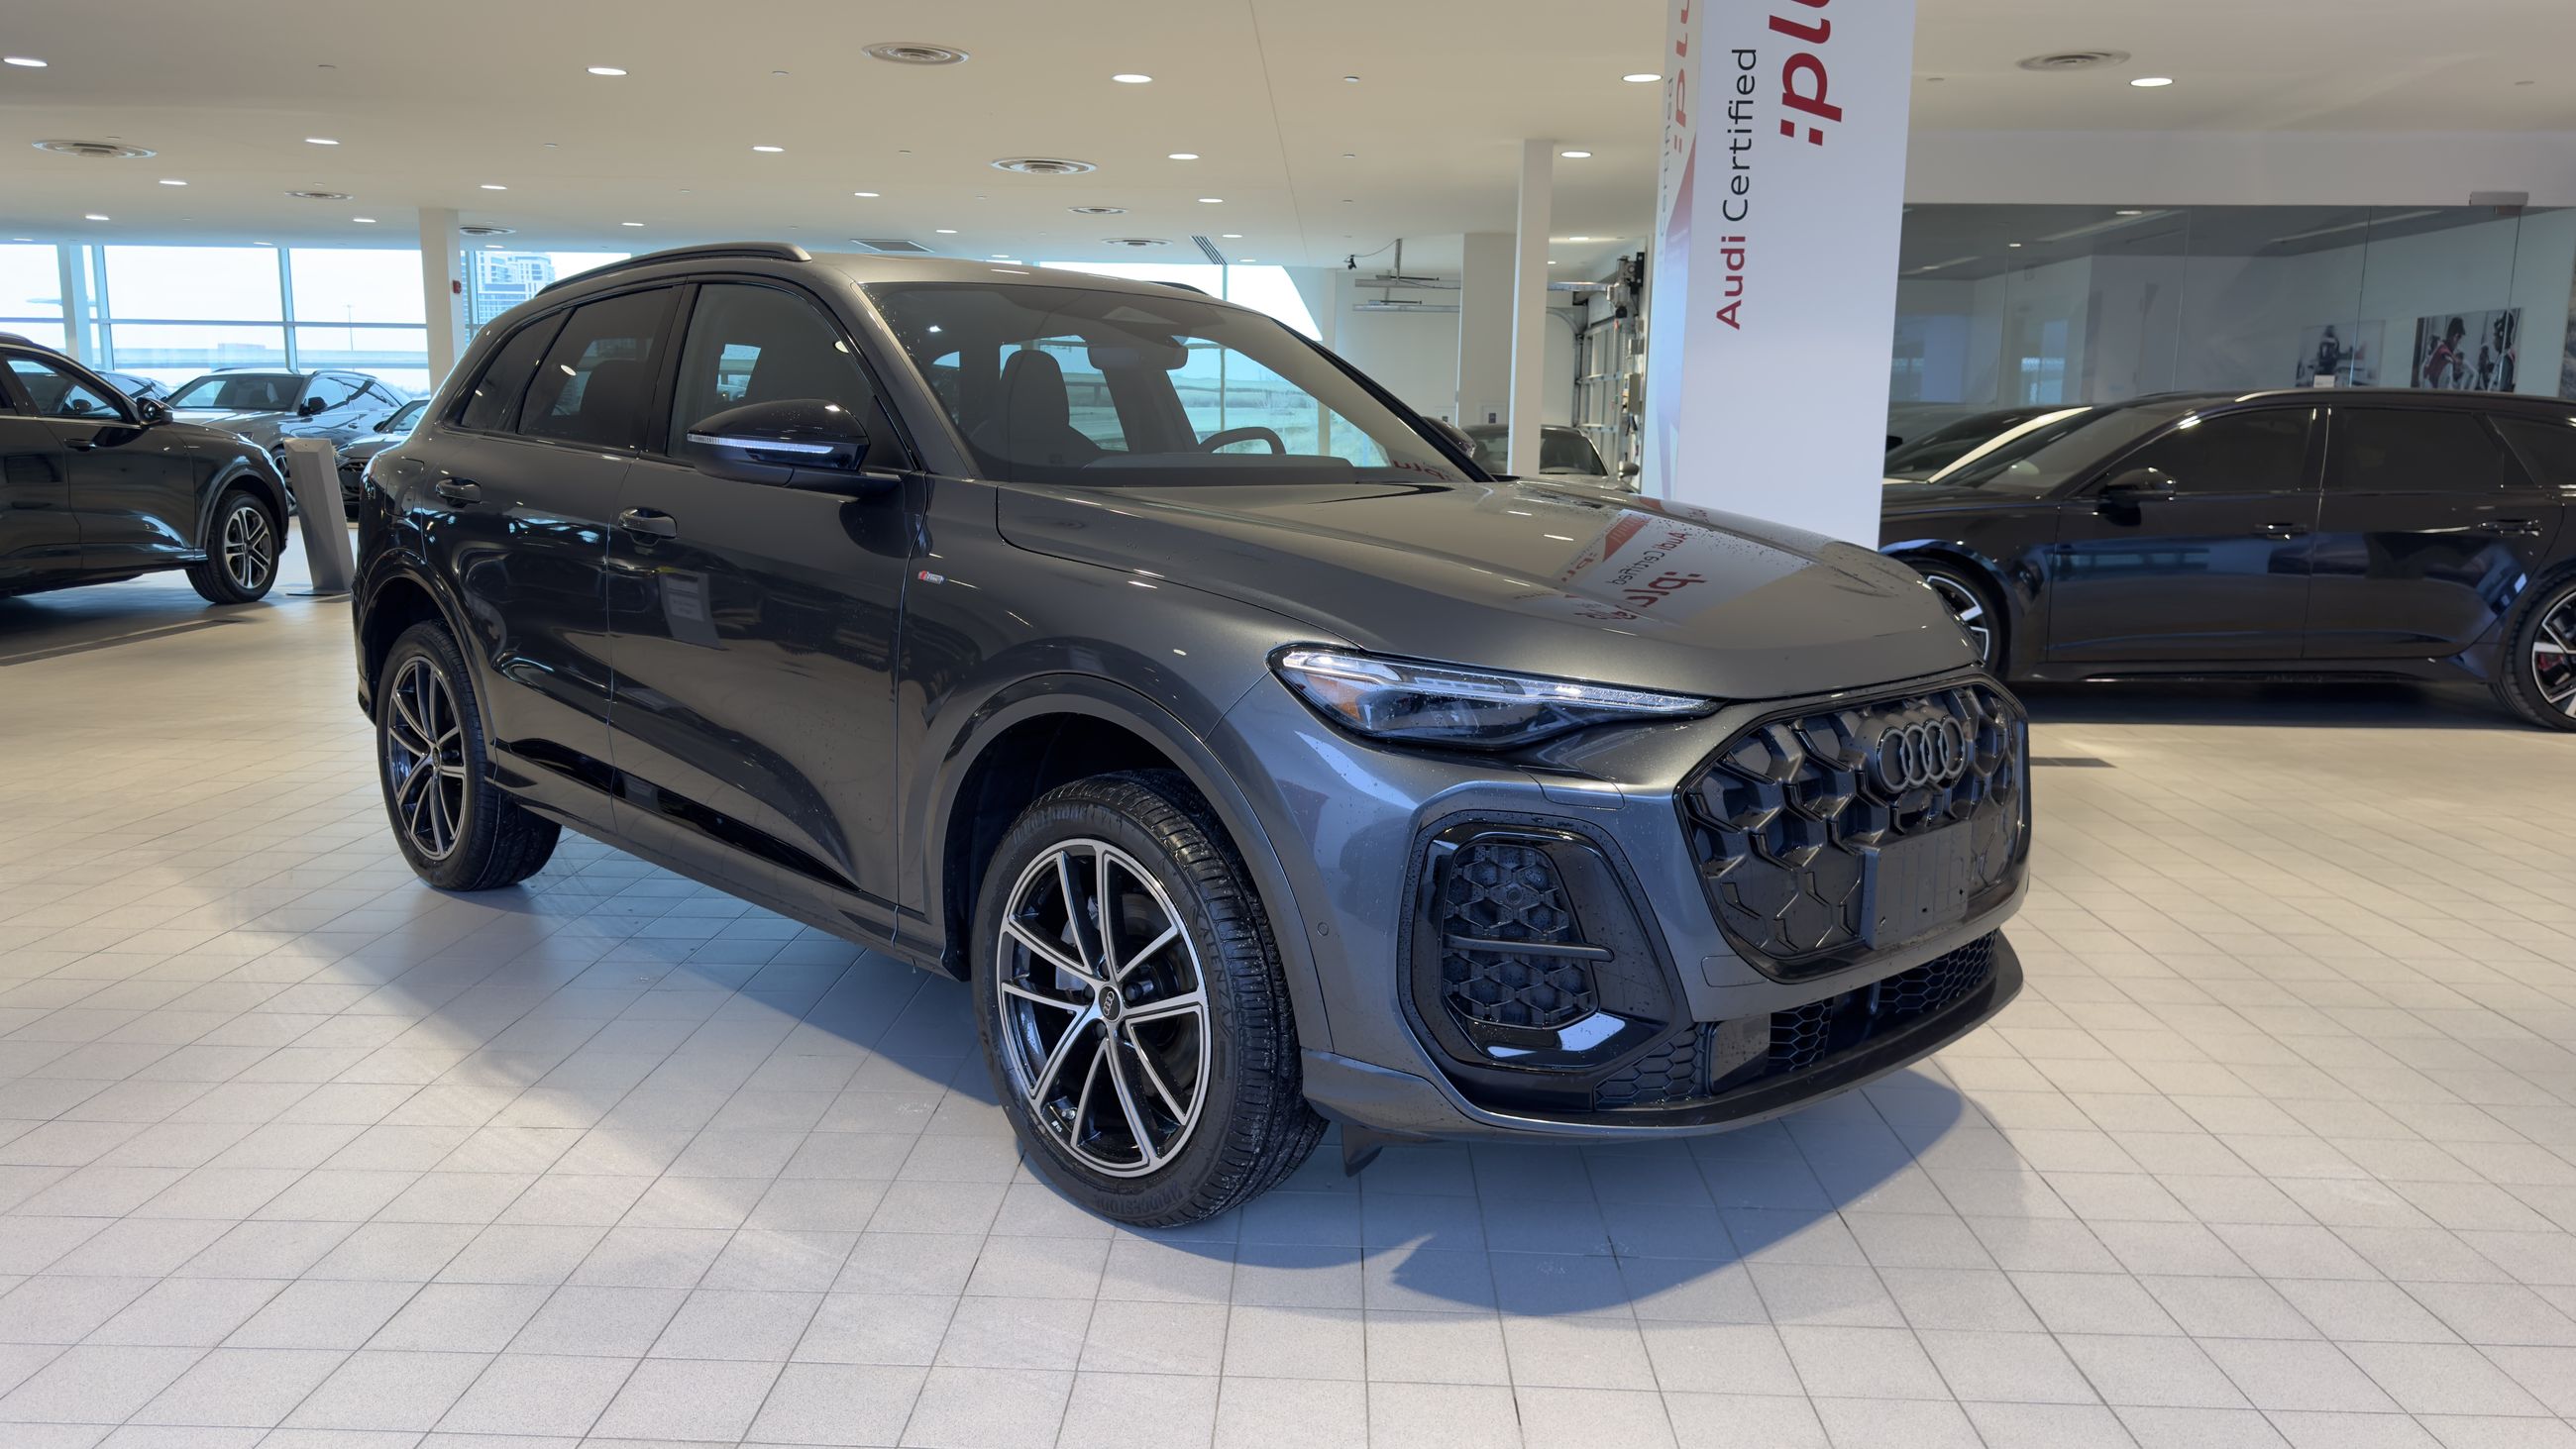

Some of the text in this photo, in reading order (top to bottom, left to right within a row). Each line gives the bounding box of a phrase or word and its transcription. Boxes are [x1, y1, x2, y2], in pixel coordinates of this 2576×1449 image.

[1769, 0, 1843, 146] :pl
[1716, 49, 1757, 331] Audi Certified
